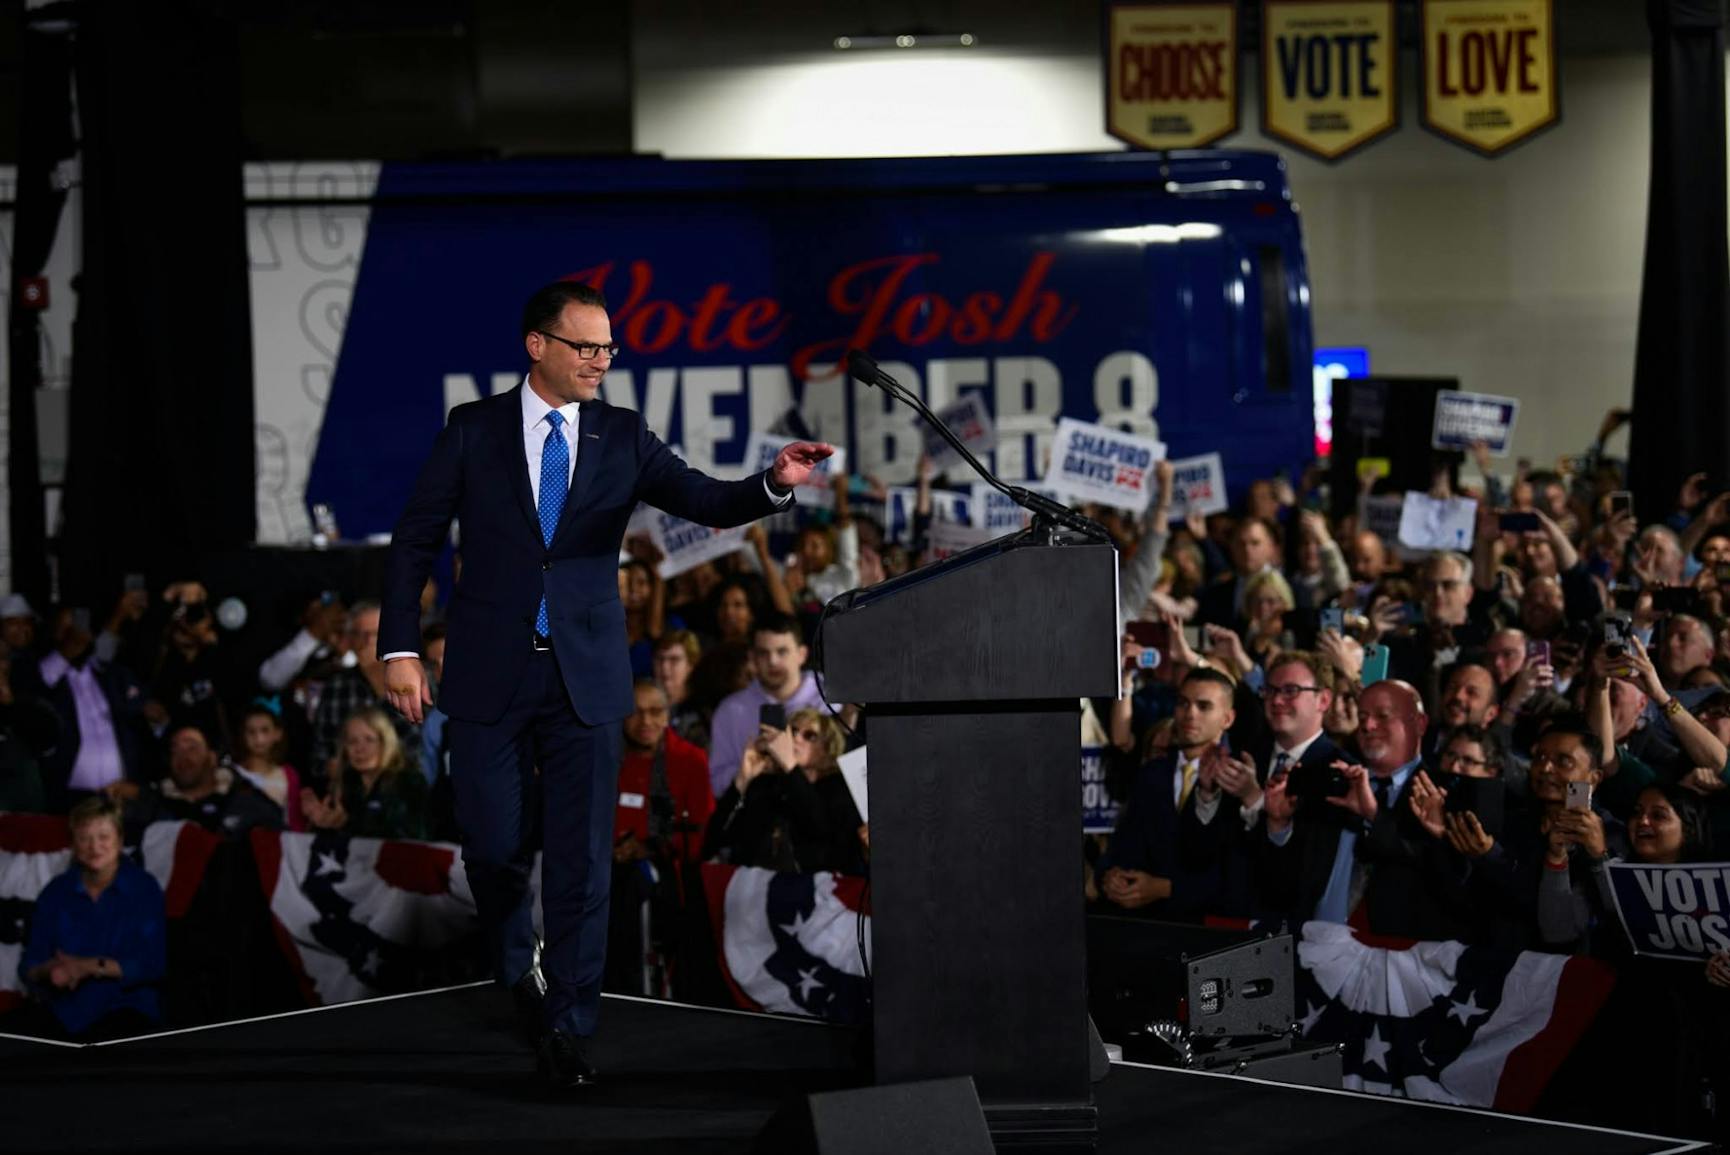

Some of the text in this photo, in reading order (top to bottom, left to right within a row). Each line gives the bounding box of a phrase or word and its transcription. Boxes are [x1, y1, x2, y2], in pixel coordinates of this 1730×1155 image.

[1120, 42, 1226, 101] CHOOSE
[1276, 33, 1380, 98] VOTE
[1437, 29, 1539, 96] LOVE
[790, 250, 1081, 382] Josh
[1063, 453, 1114, 483] DAVIS
[1070, 430, 1151, 469] SHAPIRO
[1647, 912, 1730, 953] JOS
